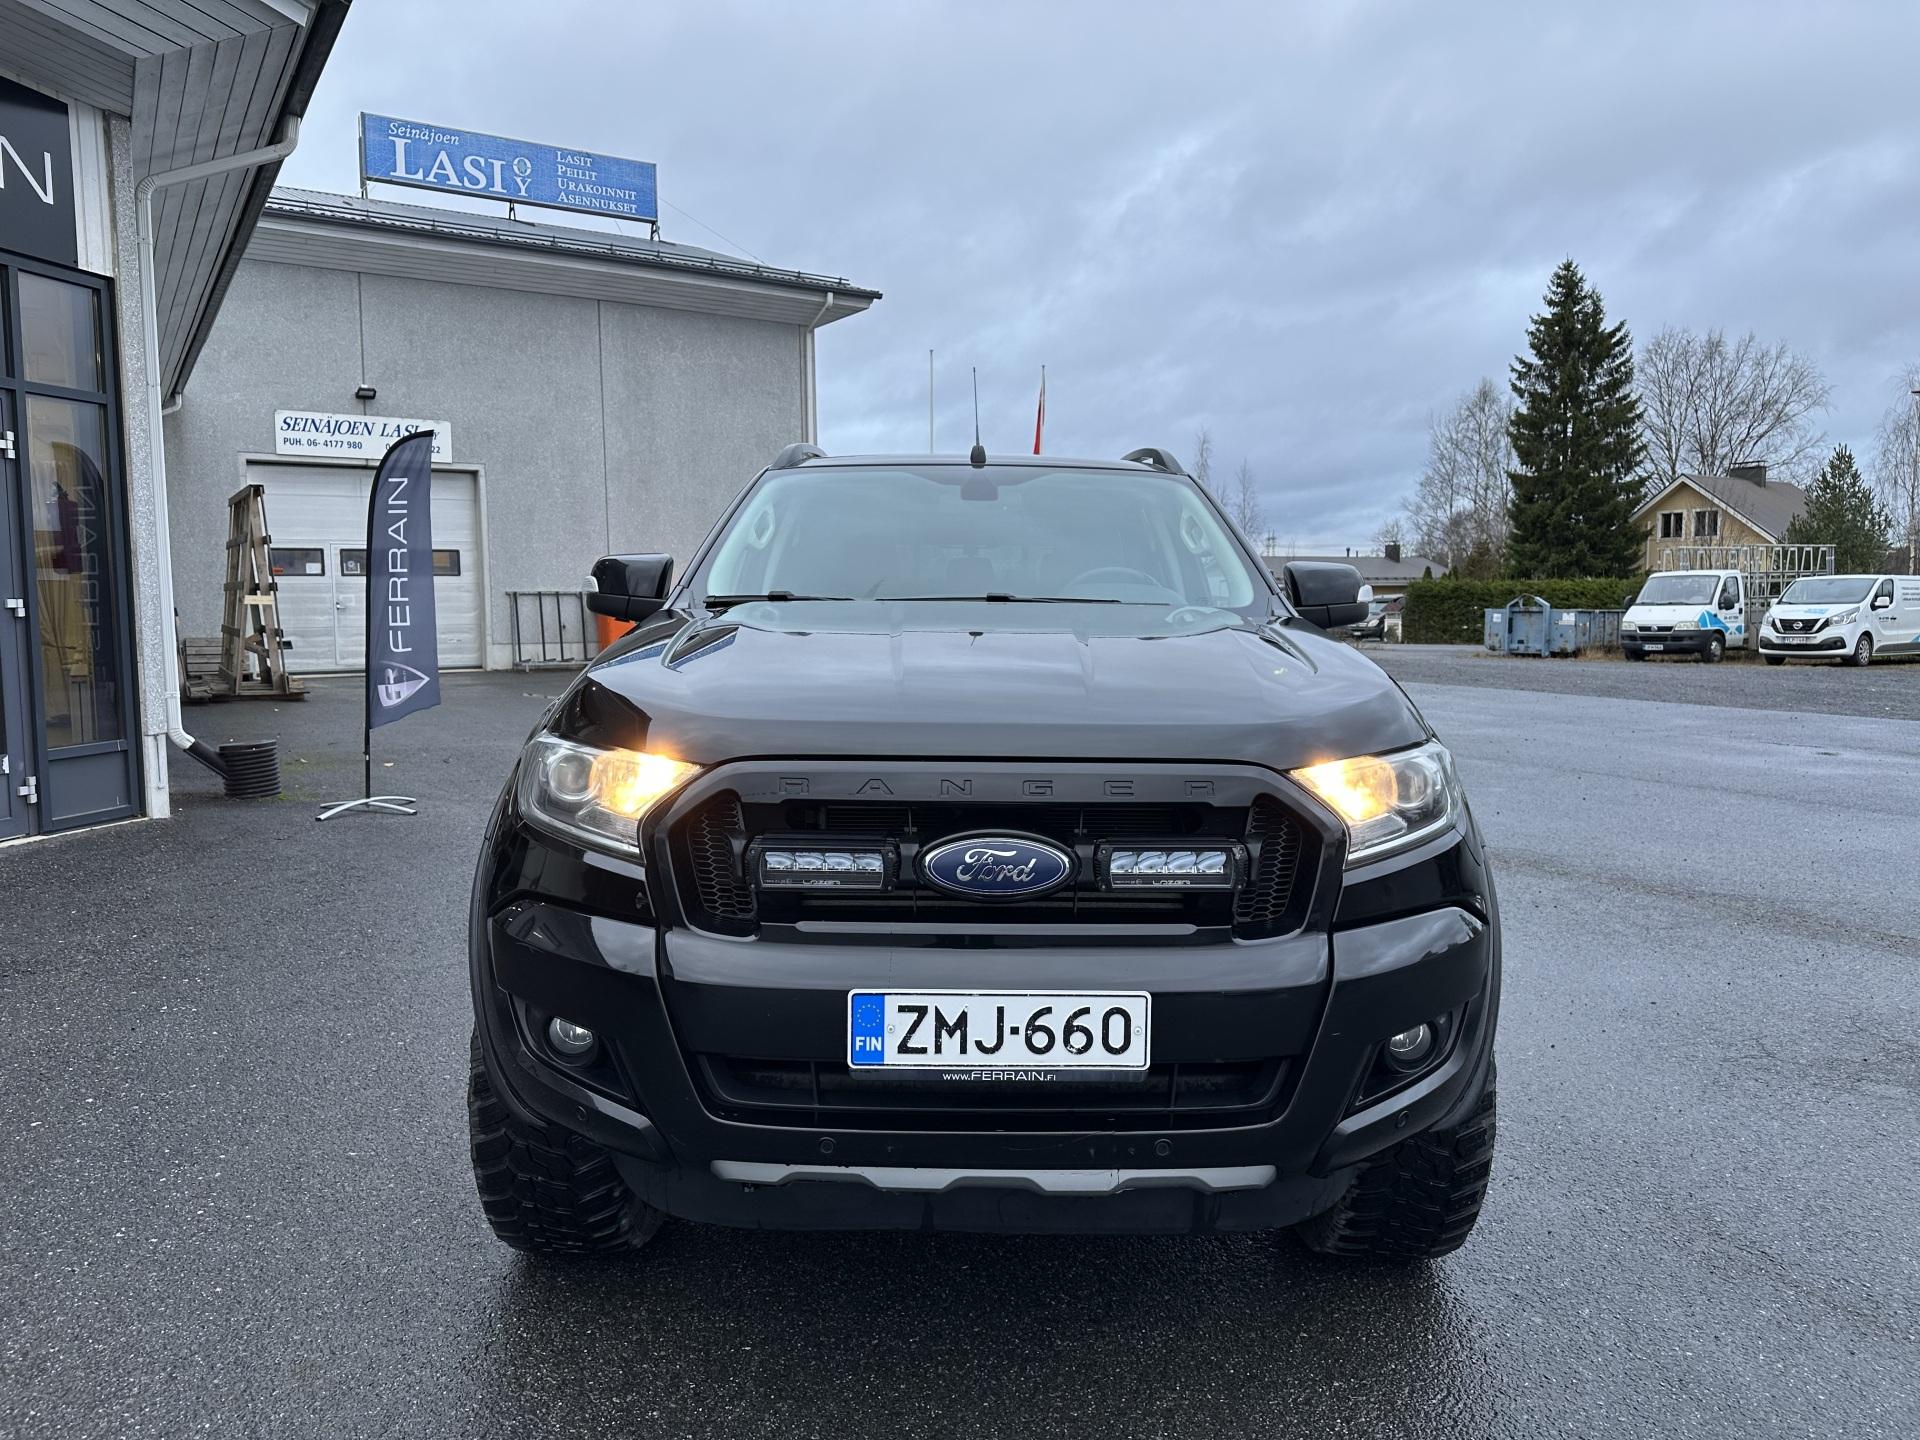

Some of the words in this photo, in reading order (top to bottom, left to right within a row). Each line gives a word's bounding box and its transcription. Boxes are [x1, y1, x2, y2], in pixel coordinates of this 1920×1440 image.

[388, 122, 460, 145] Seinäjoen
[388, 136, 507, 193] LASI
[556, 150, 593, 168] LASIT
[556, 164, 598, 181] PEILIT
[280, 415, 376, 437] SEINÄJOEN
[283, 437, 304, 447] PUH.
[322, 440, 344, 449] 4177
[346, 440, 363, 450] 980
[387, 477, 413, 653] FERRAIN
[779, 776, 1217, 797] RANGER
[956, 848, 1037, 882] Ford
[855, 1036, 882, 1051] FIN
[897, 1004, 1132, 1055] ZMJ-660
